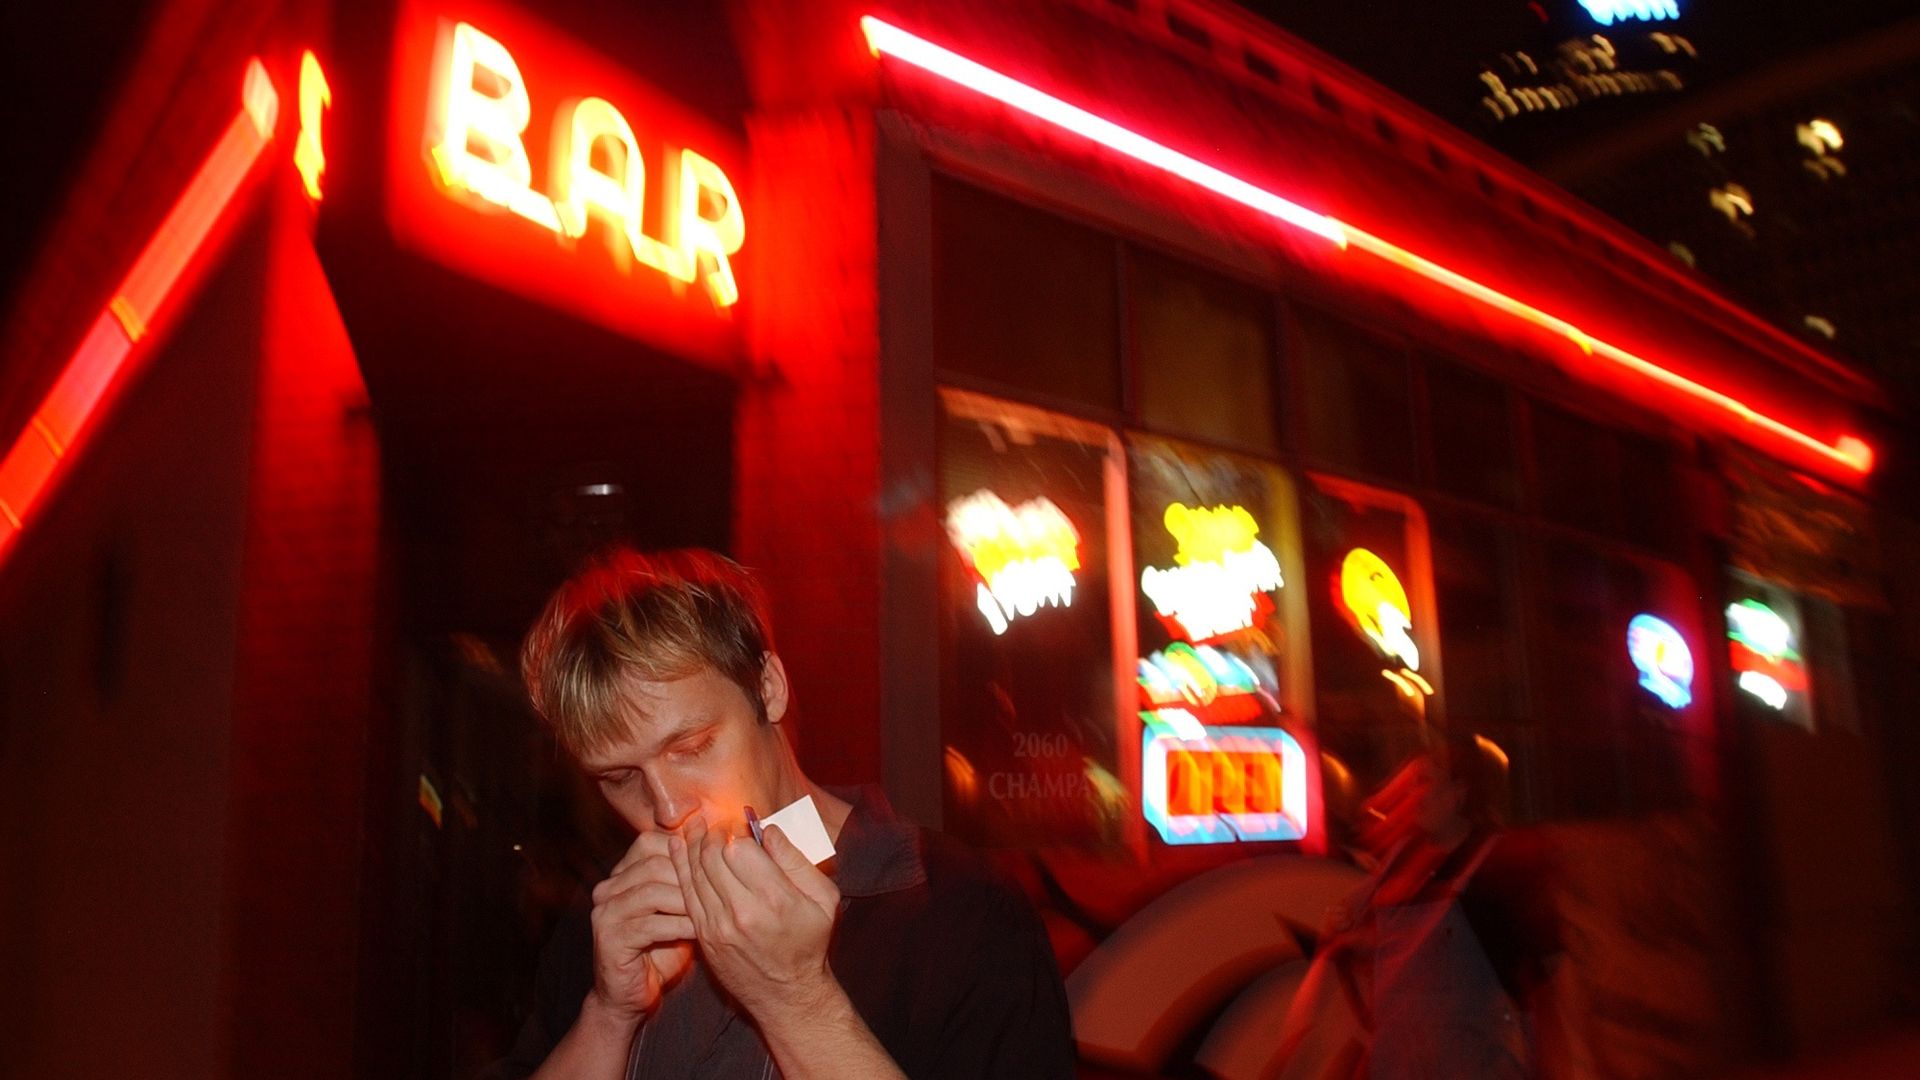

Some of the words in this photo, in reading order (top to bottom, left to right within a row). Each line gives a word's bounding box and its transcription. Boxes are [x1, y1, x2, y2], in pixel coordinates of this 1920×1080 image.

[434, 22, 746, 307] BAR
[1012, 731, 1069, 758] 2060
[988, 772, 1093, 800] CHAMPA
